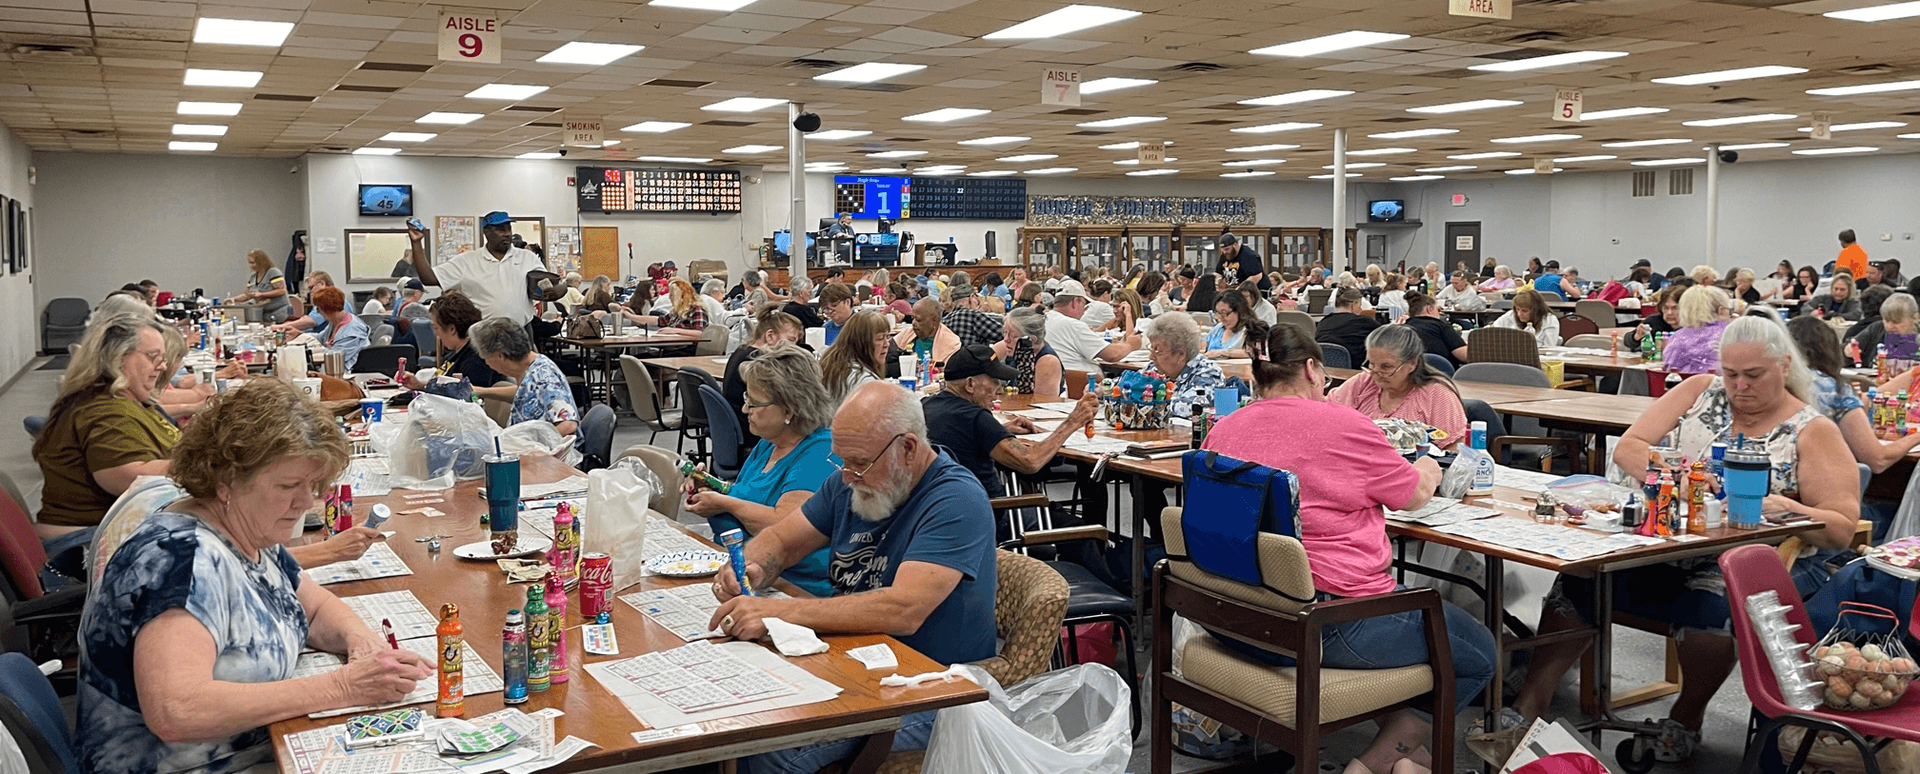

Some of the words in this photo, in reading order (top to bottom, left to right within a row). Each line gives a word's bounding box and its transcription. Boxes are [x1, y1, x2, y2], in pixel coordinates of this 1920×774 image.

[1469, 0, 1493, 13] AREA
[446, 17, 495, 32] AISLE
[458, 34, 483, 58] 9
[1047, 71, 1077, 82] AISLE
[1056, 84, 1070, 102] 7
[1557, 92, 1579, 102] AISLE
[1562, 103, 1573, 118] 5
[566, 122, 600, 131] SMOKING
[574, 134, 594, 142] AREA
[378, 200, 394, 209] 45
[878, 192, 891, 214] 1
[1105, 200, 1174, 215] ATHLETIC
[1182, 200, 1250, 216] BOOSTERS
